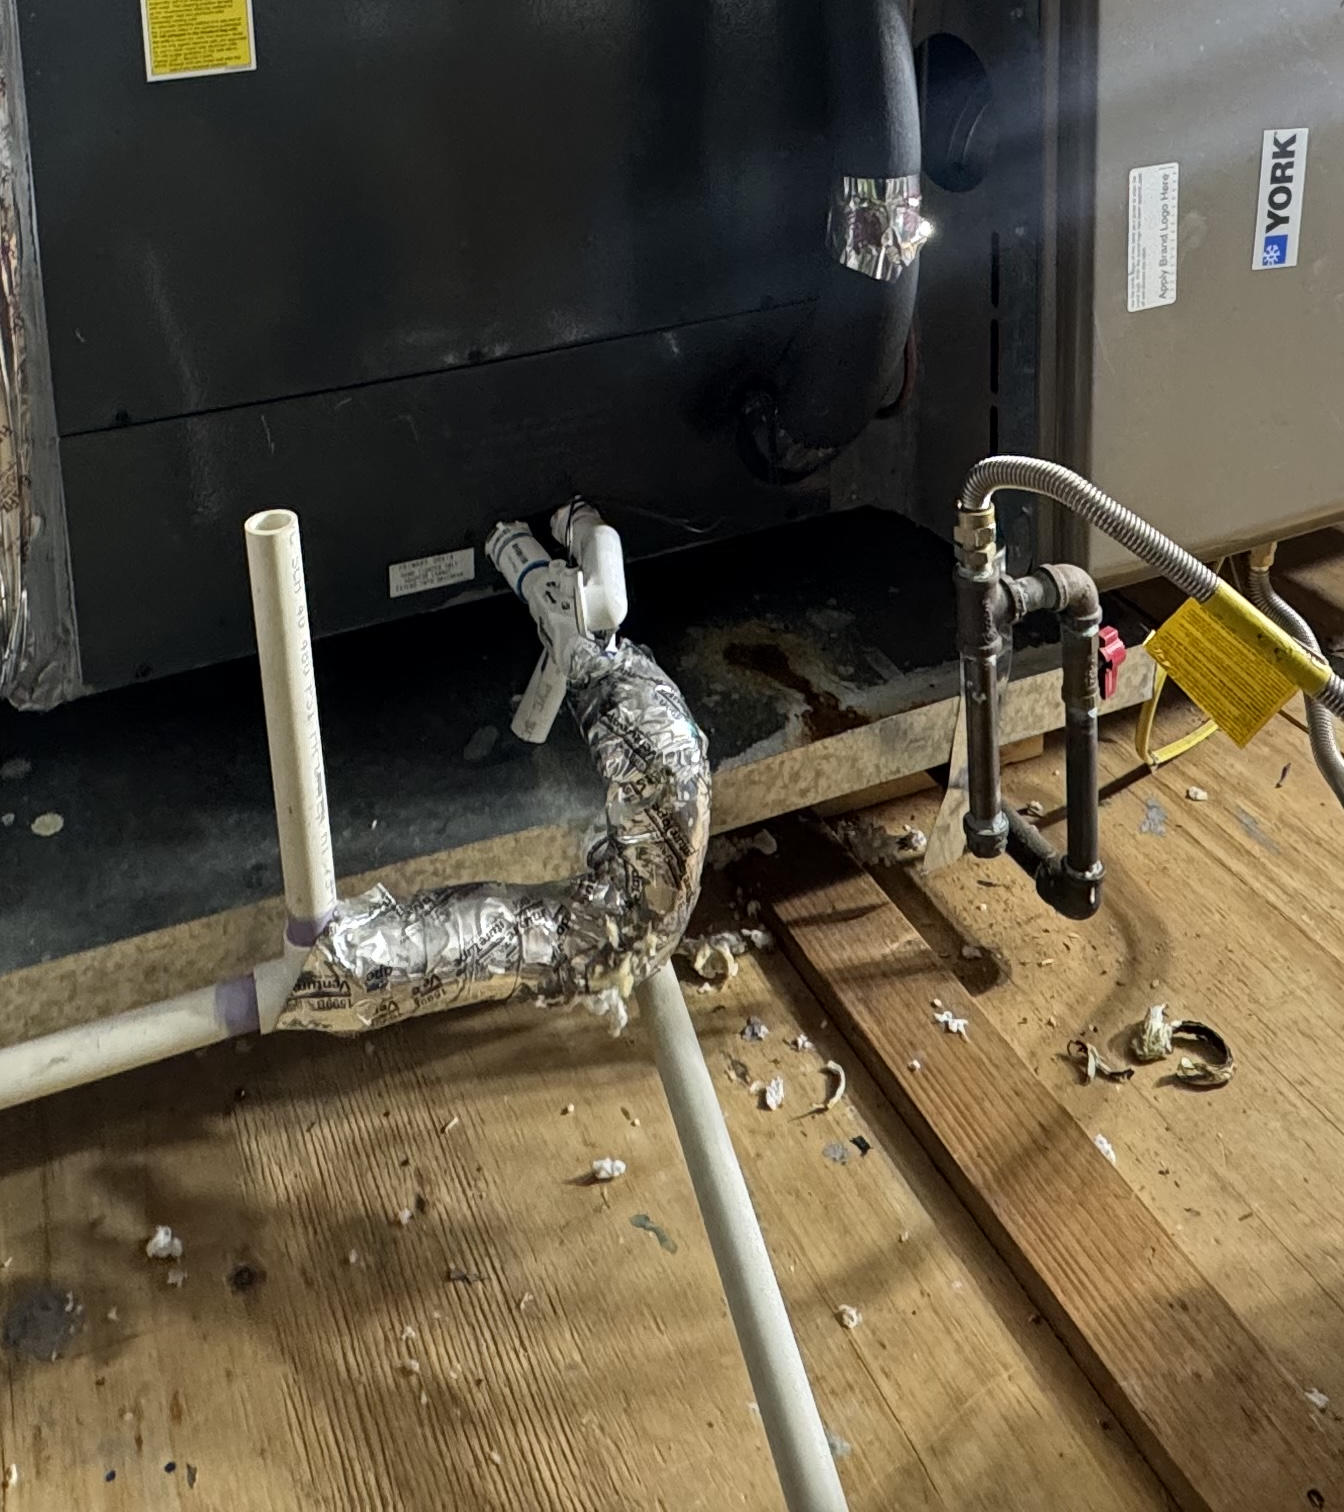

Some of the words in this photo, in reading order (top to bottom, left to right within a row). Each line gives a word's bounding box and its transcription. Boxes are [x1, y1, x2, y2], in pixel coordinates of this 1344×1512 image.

[1160, 172, 1172, 201] Here
[1265, 131, 1298, 234] YORK
[1159, 203, 1171, 232] Logo
[1159, 234, 1170, 267] Brand
[1158, 269, 1170, 300] Apply
